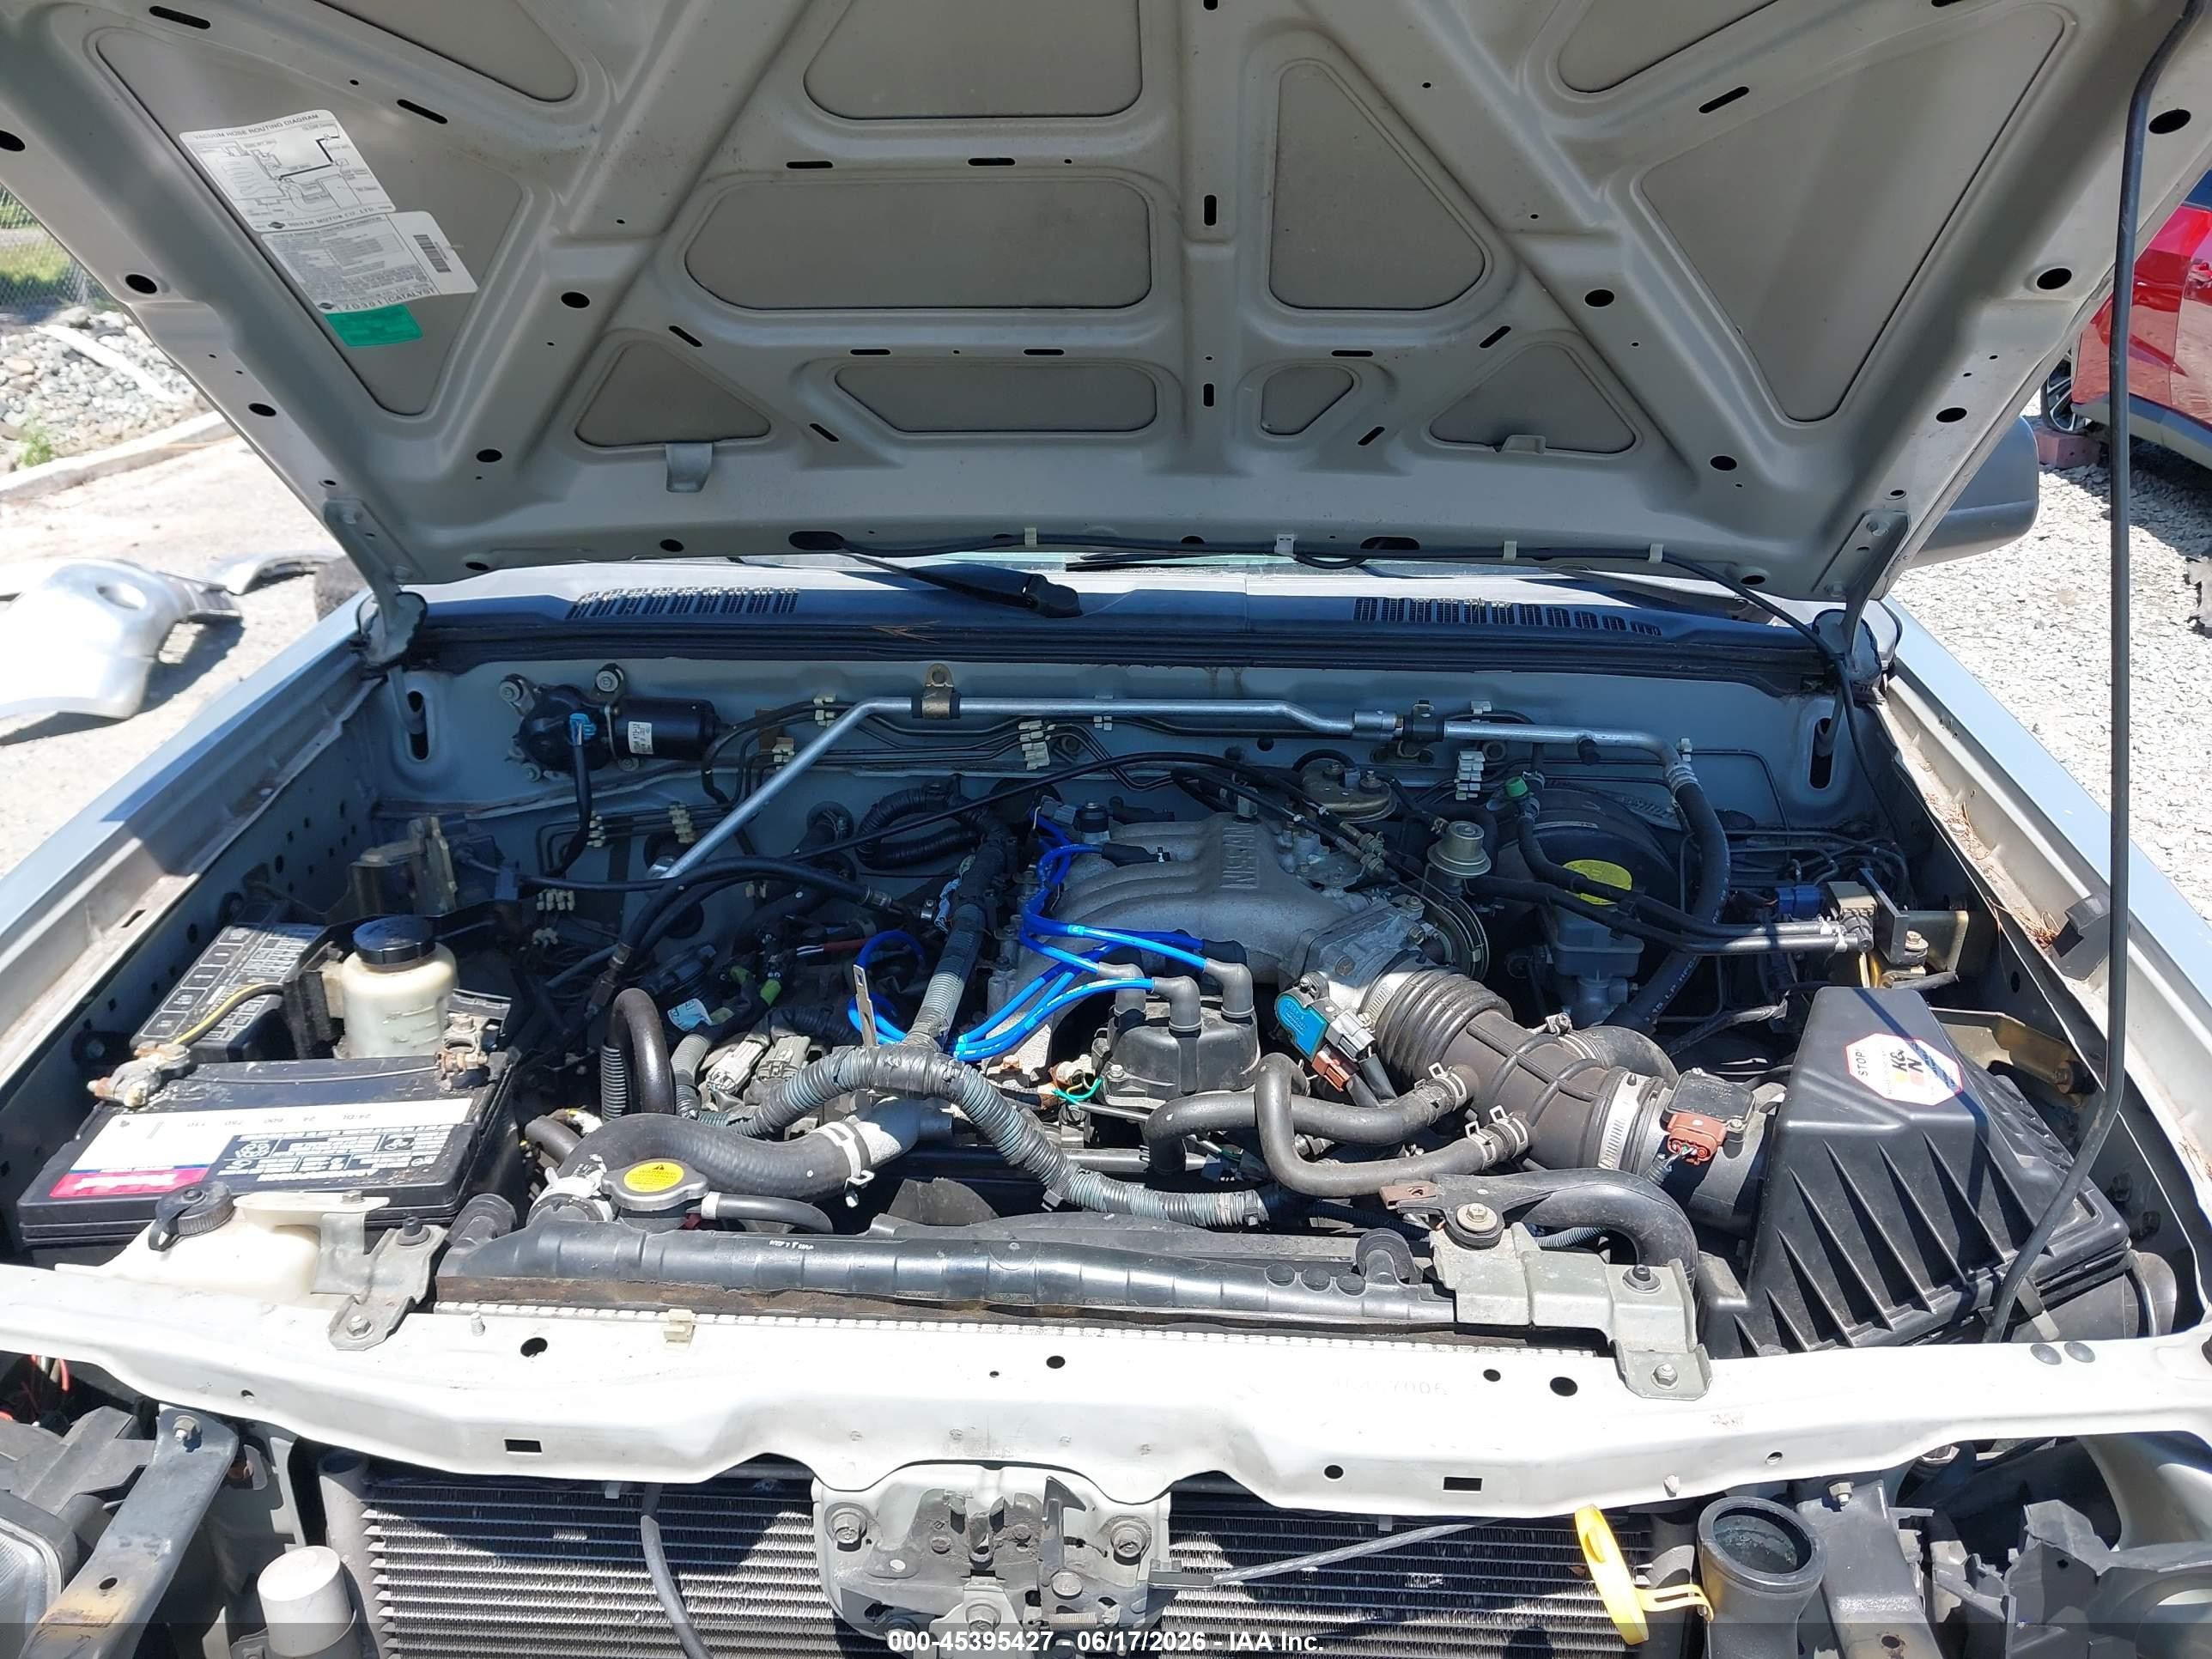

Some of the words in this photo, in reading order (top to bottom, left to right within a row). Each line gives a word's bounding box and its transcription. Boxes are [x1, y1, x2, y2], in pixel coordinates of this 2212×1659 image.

[249, 121, 283, 135] ROUTING
[283, 113, 319, 126] DIAGRAM
[388, 287, 435, 305] CATALYST
[1221, 826, 1256, 887] NISSAN
